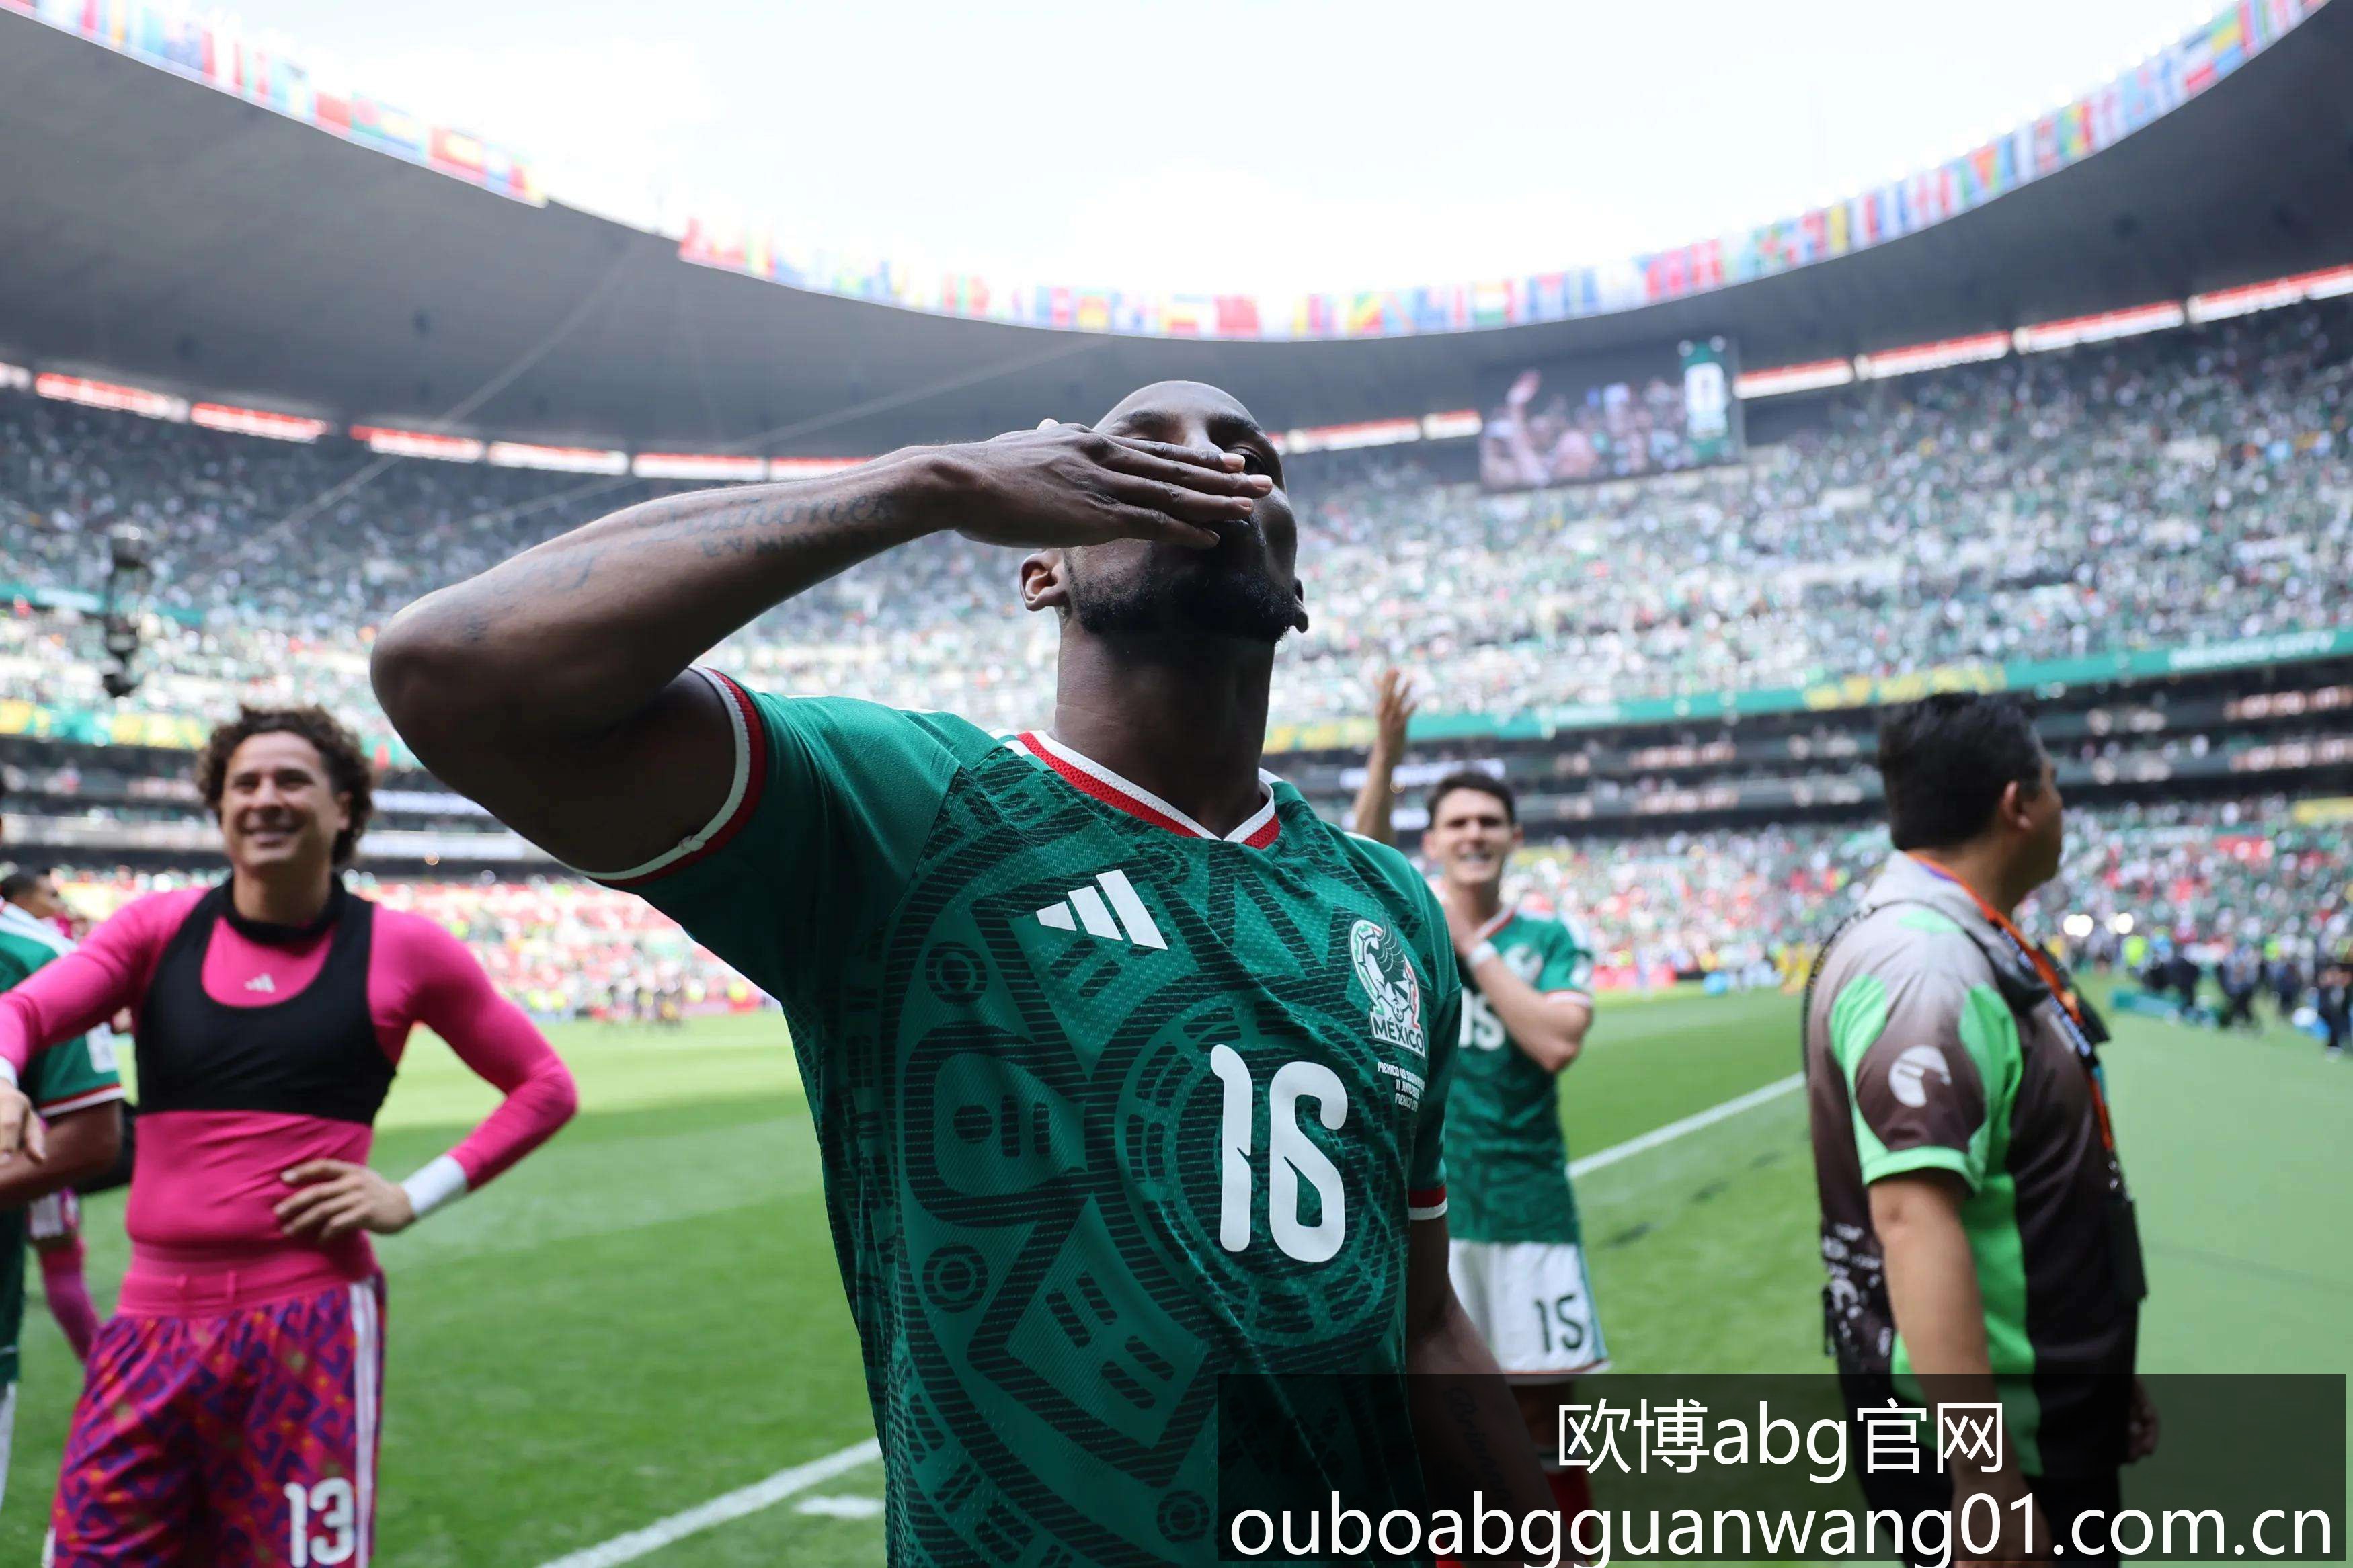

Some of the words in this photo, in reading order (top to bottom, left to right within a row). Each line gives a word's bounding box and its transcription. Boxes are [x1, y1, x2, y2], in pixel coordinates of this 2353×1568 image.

[1373, 1017, 1424, 1052] MÉXICO
[1458, 986, 1505, 1050] 15
[1209, 1044, 1348, 1263] 16
[1533, 1293, 1585, 1352] 15
[283, 1477, 356, 1568] 13
